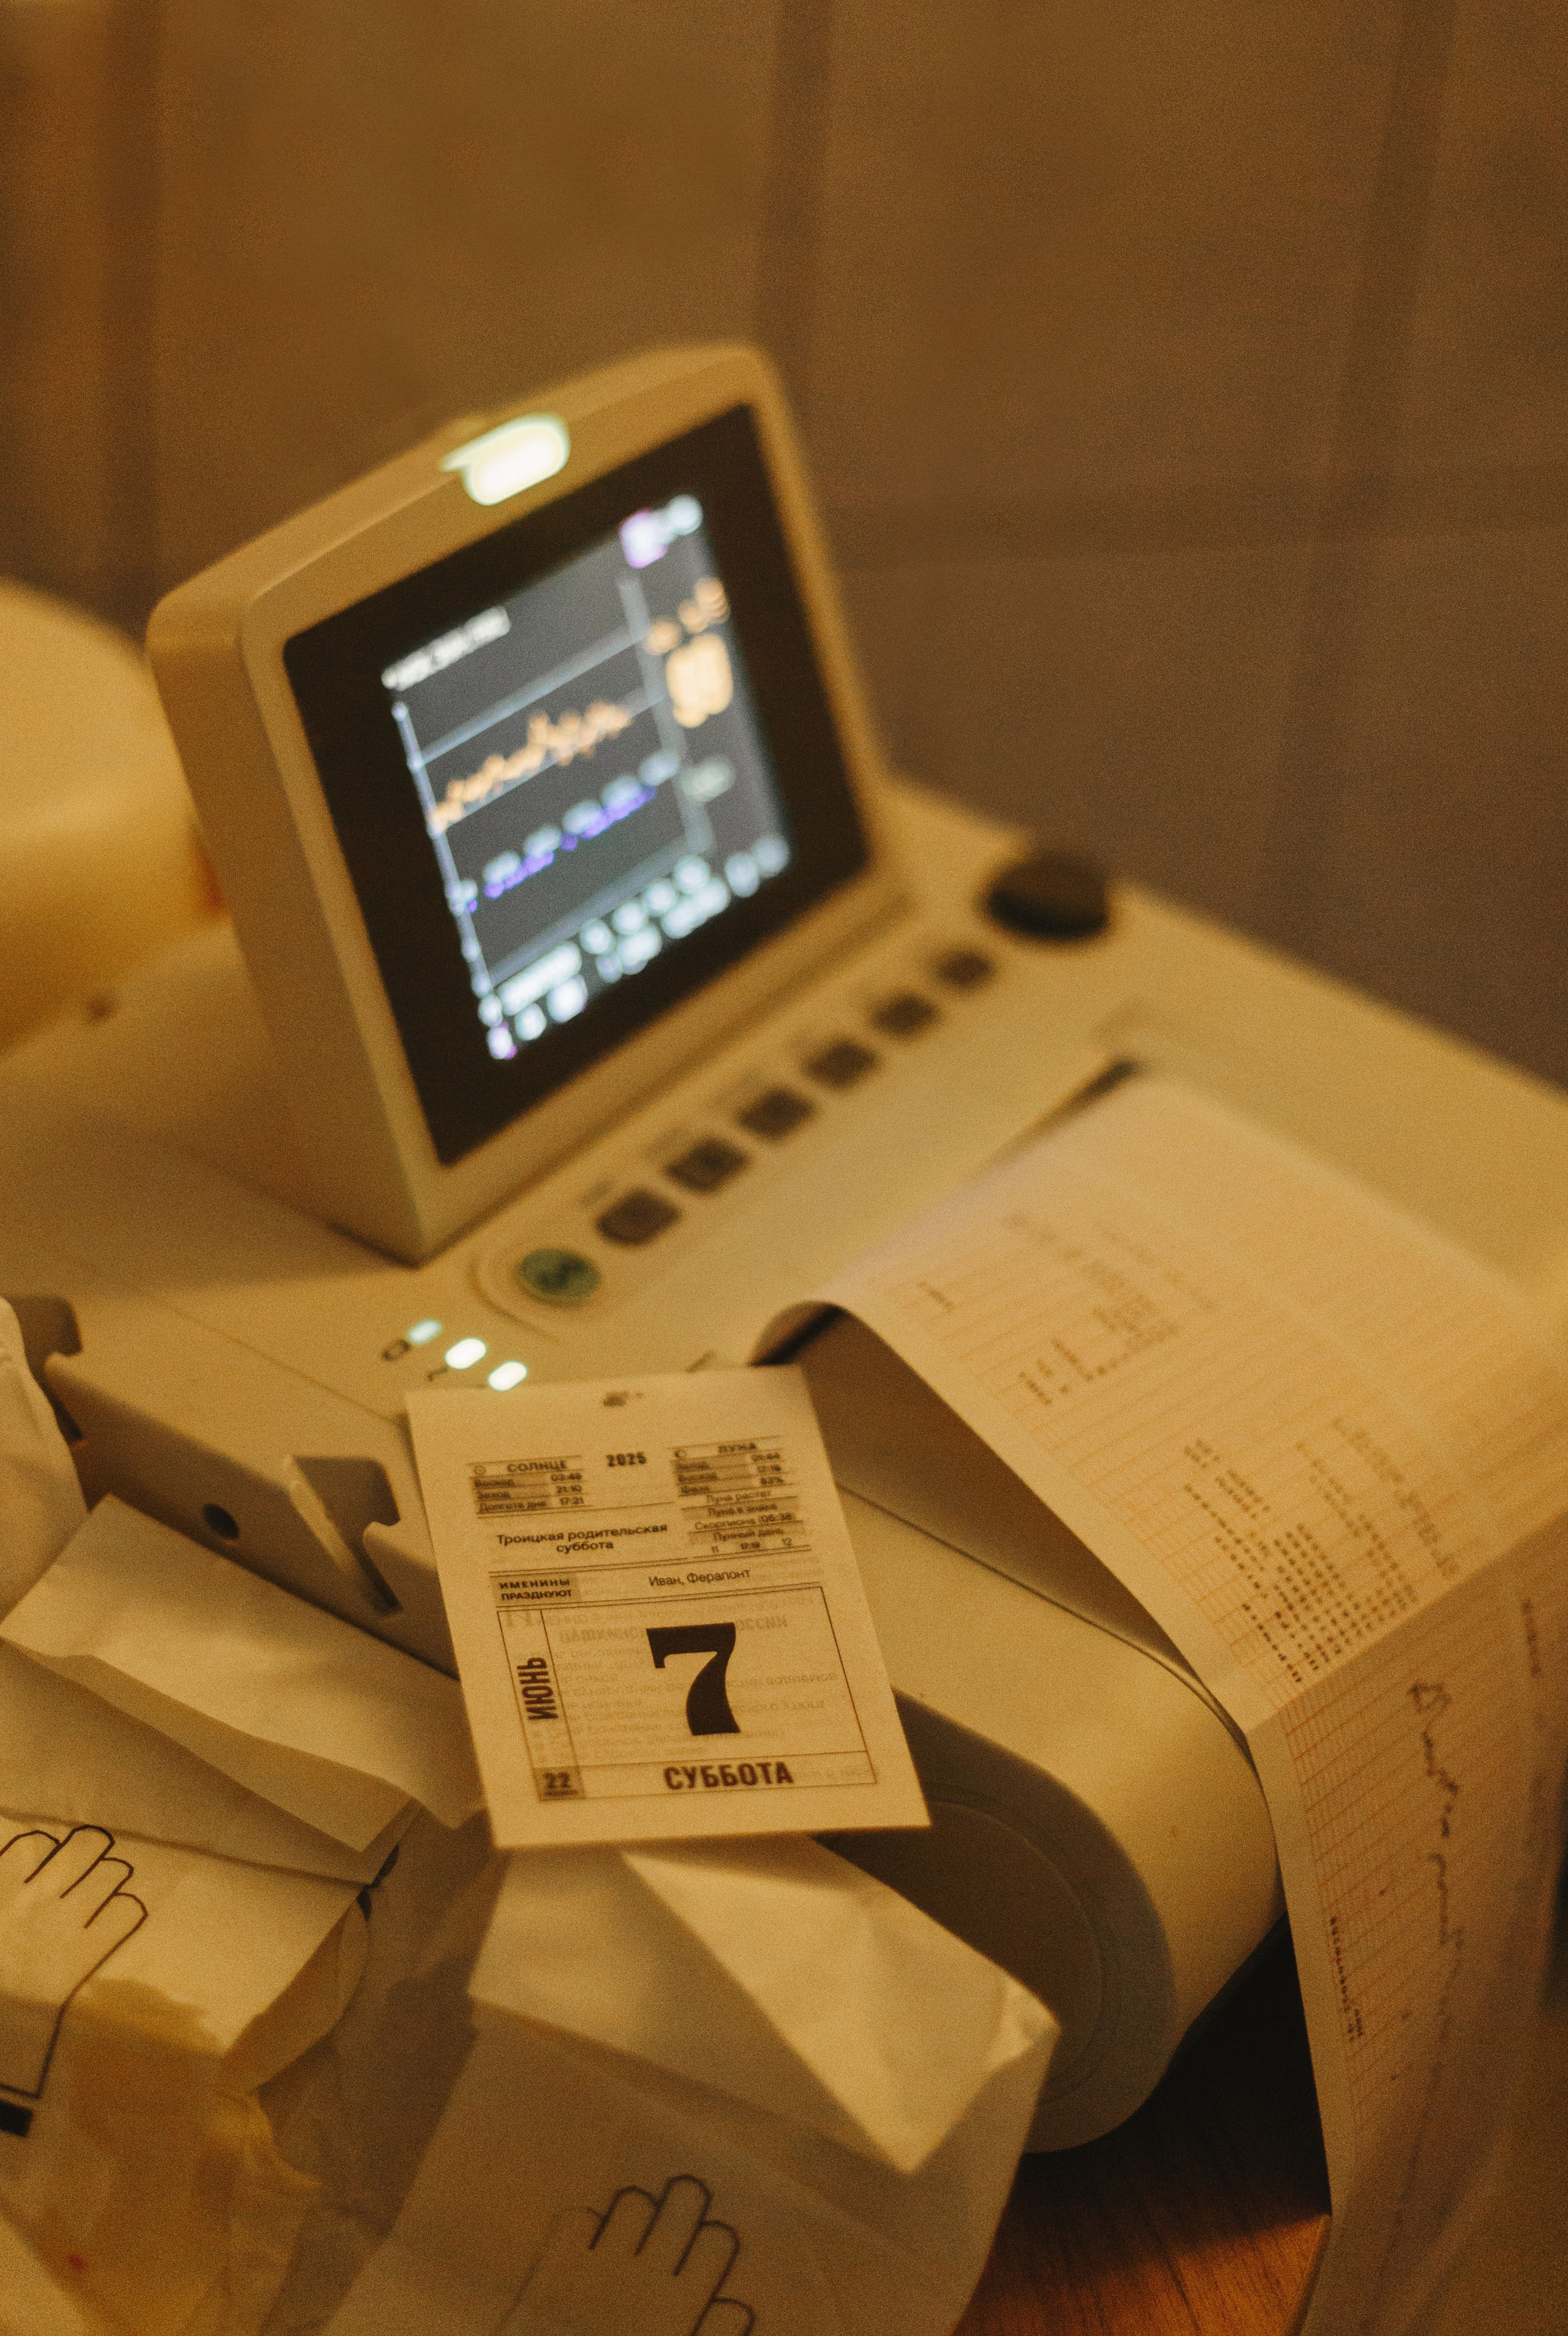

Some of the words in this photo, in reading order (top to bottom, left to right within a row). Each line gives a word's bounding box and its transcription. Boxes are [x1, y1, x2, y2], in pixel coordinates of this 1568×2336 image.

[507, 1460, 567, 1473] СОЛНЦЕ
[606, 1452, 647, 1467] 2025
[497, 1534, 565, 1547] Троицкая
[567, 1524, 668, 1541] родительская
[556, 1540, 614, 1554] суббота
[499, 1578, 571, 1589] ИМЕНИНЫ
[648, 1576, 685, 1588] Иван,
[686, 1568, 751, 1584] Ферапонт
[500, 1589, 573, 1602] ПРАЗДНУЮТ
[646, 1622, 741, 1736] 7
[516, 1657, 559, 1721] ИЮНЬ
[543, 1772, 571, 1790] 22
[663, 1761, 794, 1791] СУББОТА
